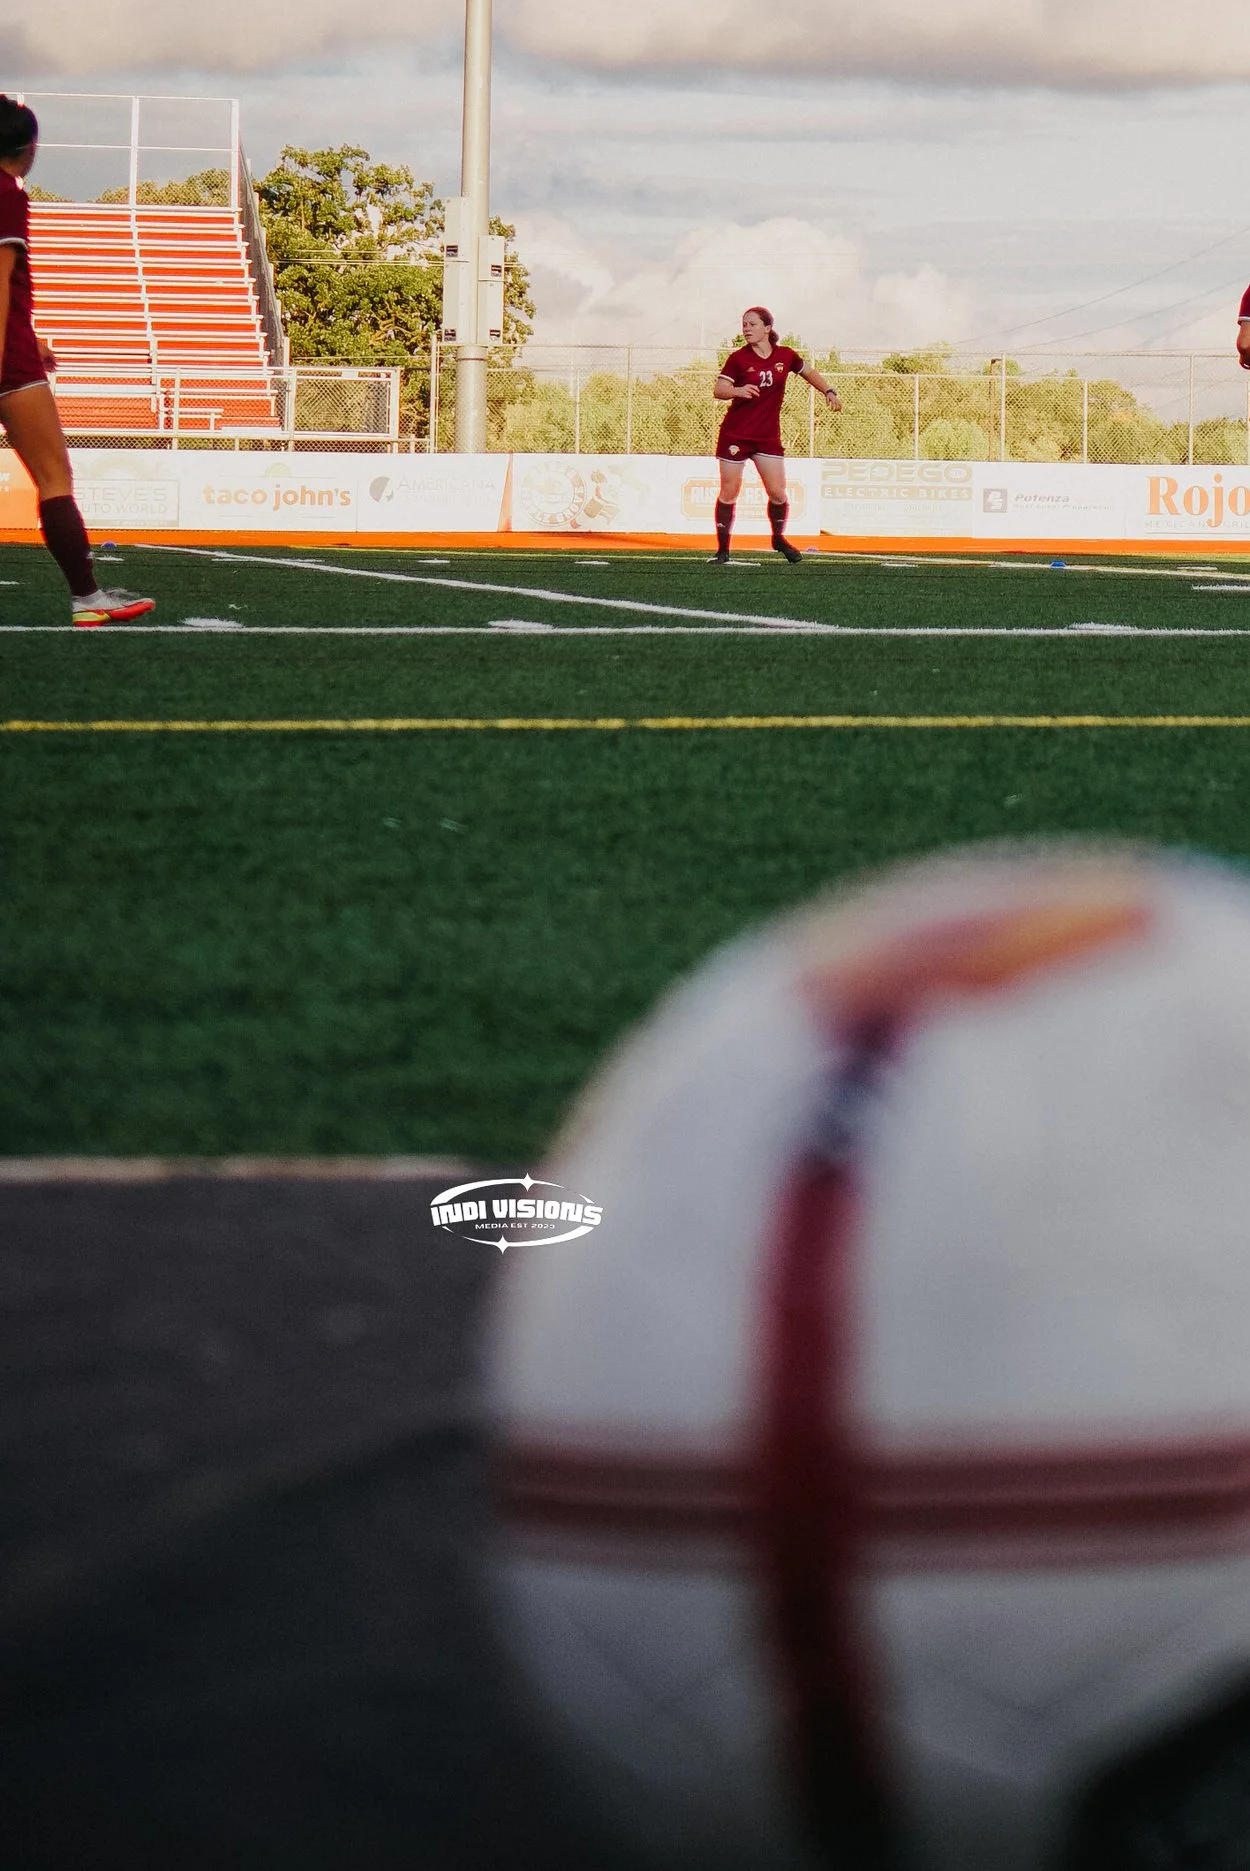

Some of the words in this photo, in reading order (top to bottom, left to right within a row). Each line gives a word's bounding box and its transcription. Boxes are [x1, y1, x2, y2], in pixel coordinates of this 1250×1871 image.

[759, 370, 773, 388] 23
[821, 461, 973, 483] PEDEGO
[202, 484, 268, 505] taco
[272, 483, 352, 511] john's
[824, 487, 910, 498] ELECTRIC
[918, 488, 970, 499] BIKES
[1014, 493, 1070, 503] Potenza
[79, 502, 111, 514] UTO
[116, 503, 168, 514] WORLD
